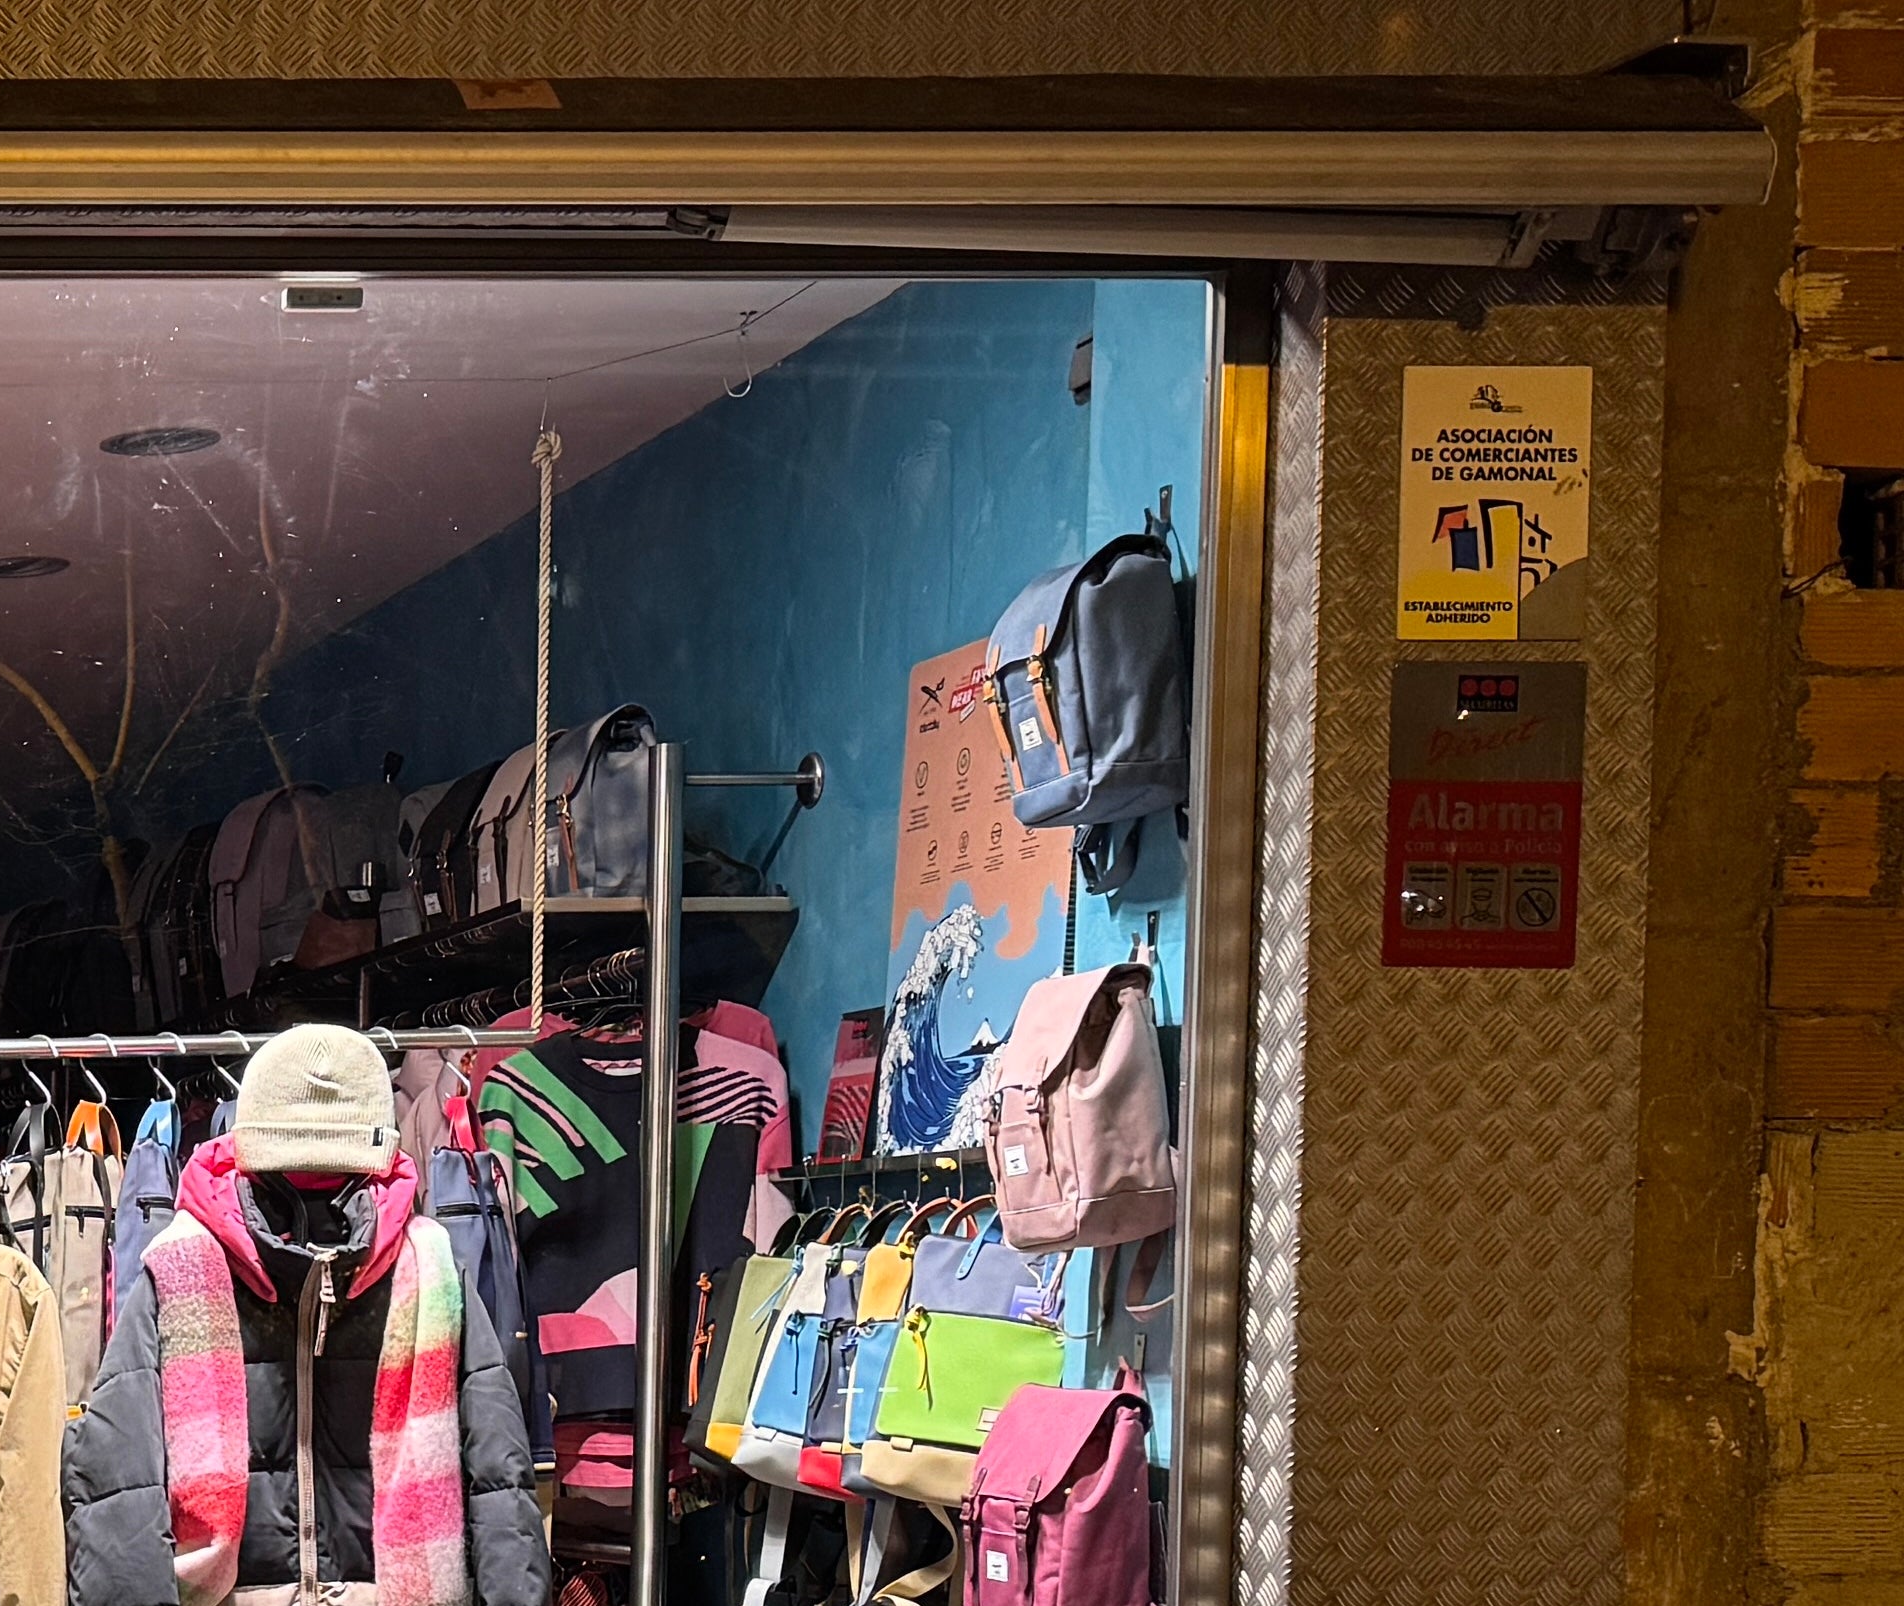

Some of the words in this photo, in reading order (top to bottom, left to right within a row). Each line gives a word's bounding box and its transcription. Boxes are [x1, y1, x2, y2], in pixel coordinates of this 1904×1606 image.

[1436, 424, 1553, 443] ASOCIACIÓN
[1411, 448, 1434, 462] DE
[1439, 447, 1578, 463] COMERCIANTES
[1431, 466, 1454, 481] DE
[1459, 466, 1557, 481] GAMONAL
[1404, 601, 1513, 611] ESTABLECIMIENTO
[1426, 613, 1491, 623] ADHERIDO
[1407, 792, 1564, 832] Alarma
